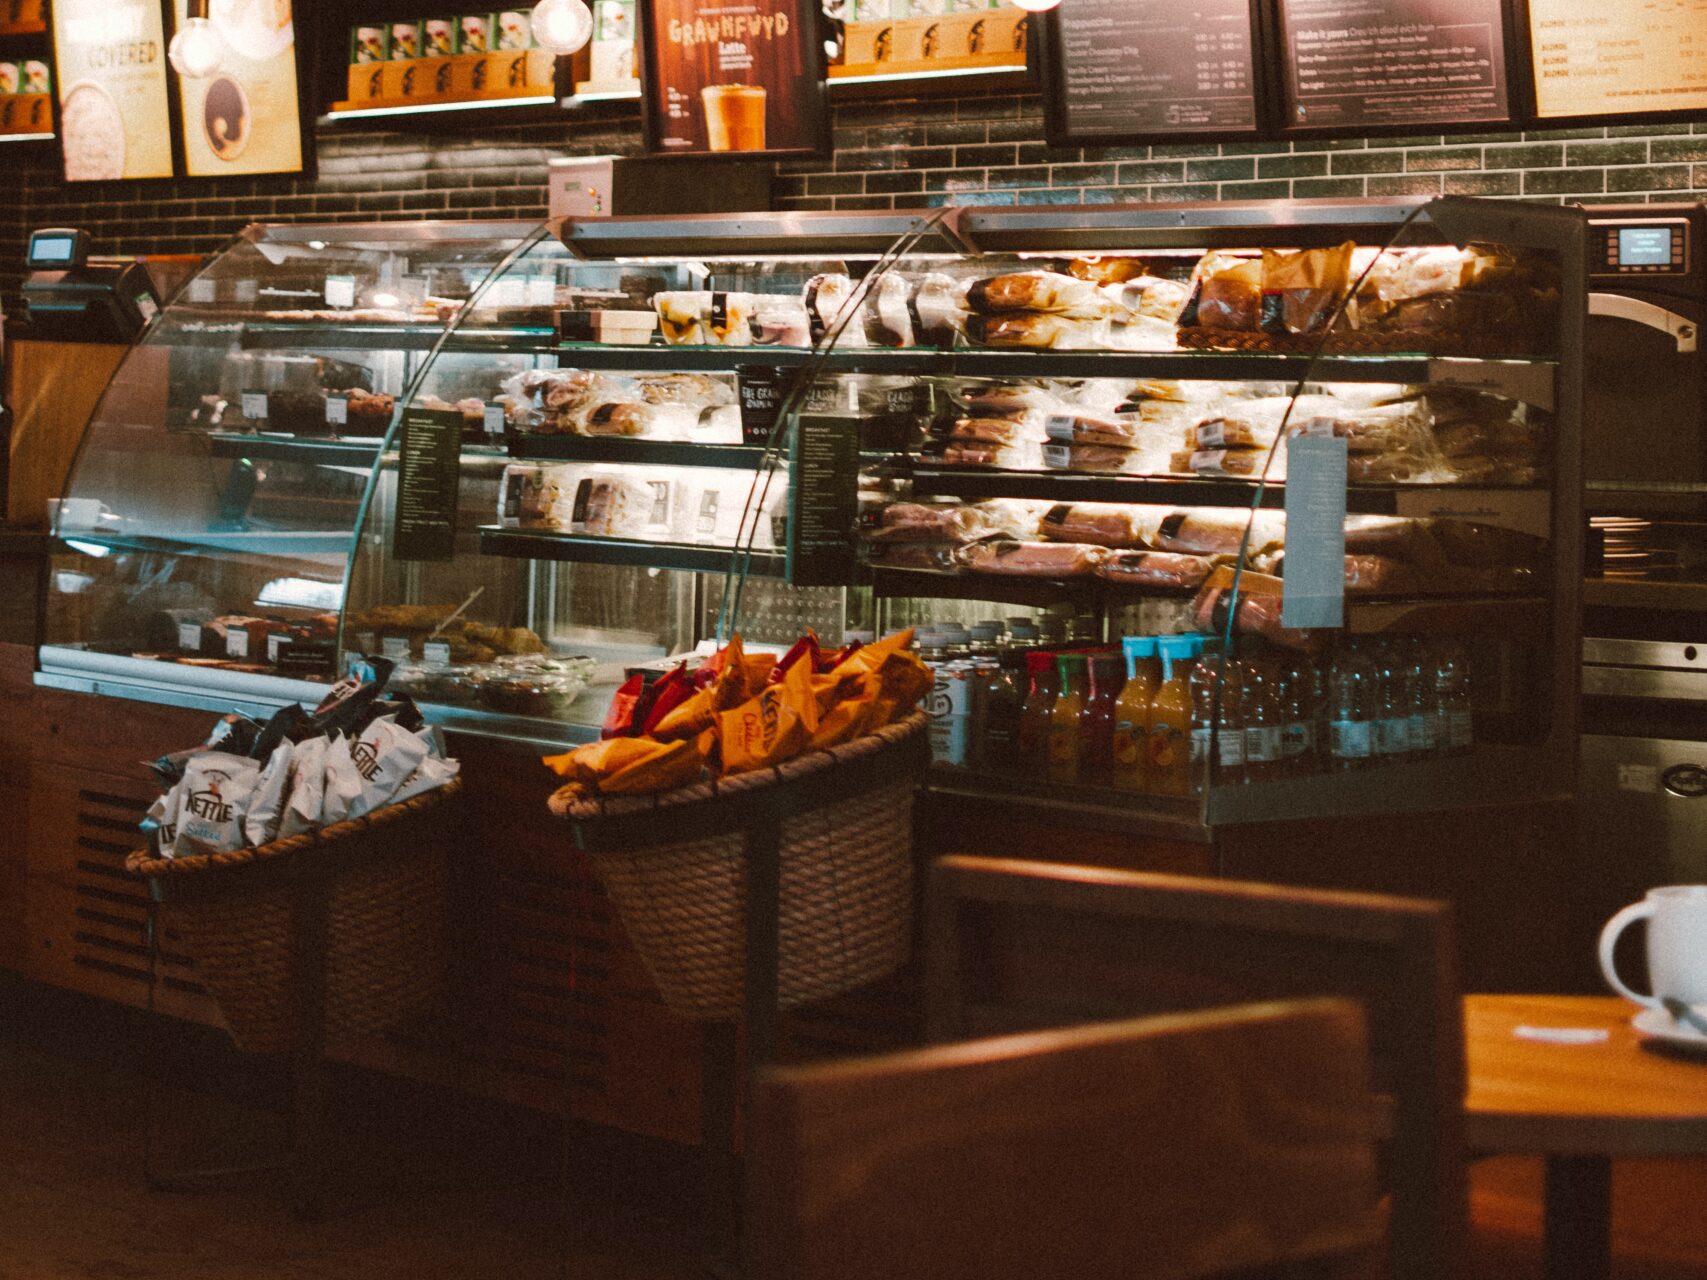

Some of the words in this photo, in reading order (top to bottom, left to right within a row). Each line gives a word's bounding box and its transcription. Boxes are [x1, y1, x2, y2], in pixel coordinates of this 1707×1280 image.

[668, 11, 790, 48] GRAWNFWYD
[718, 40, 747, 55] Latte
[185, 788, 234, 824] KETTLE
